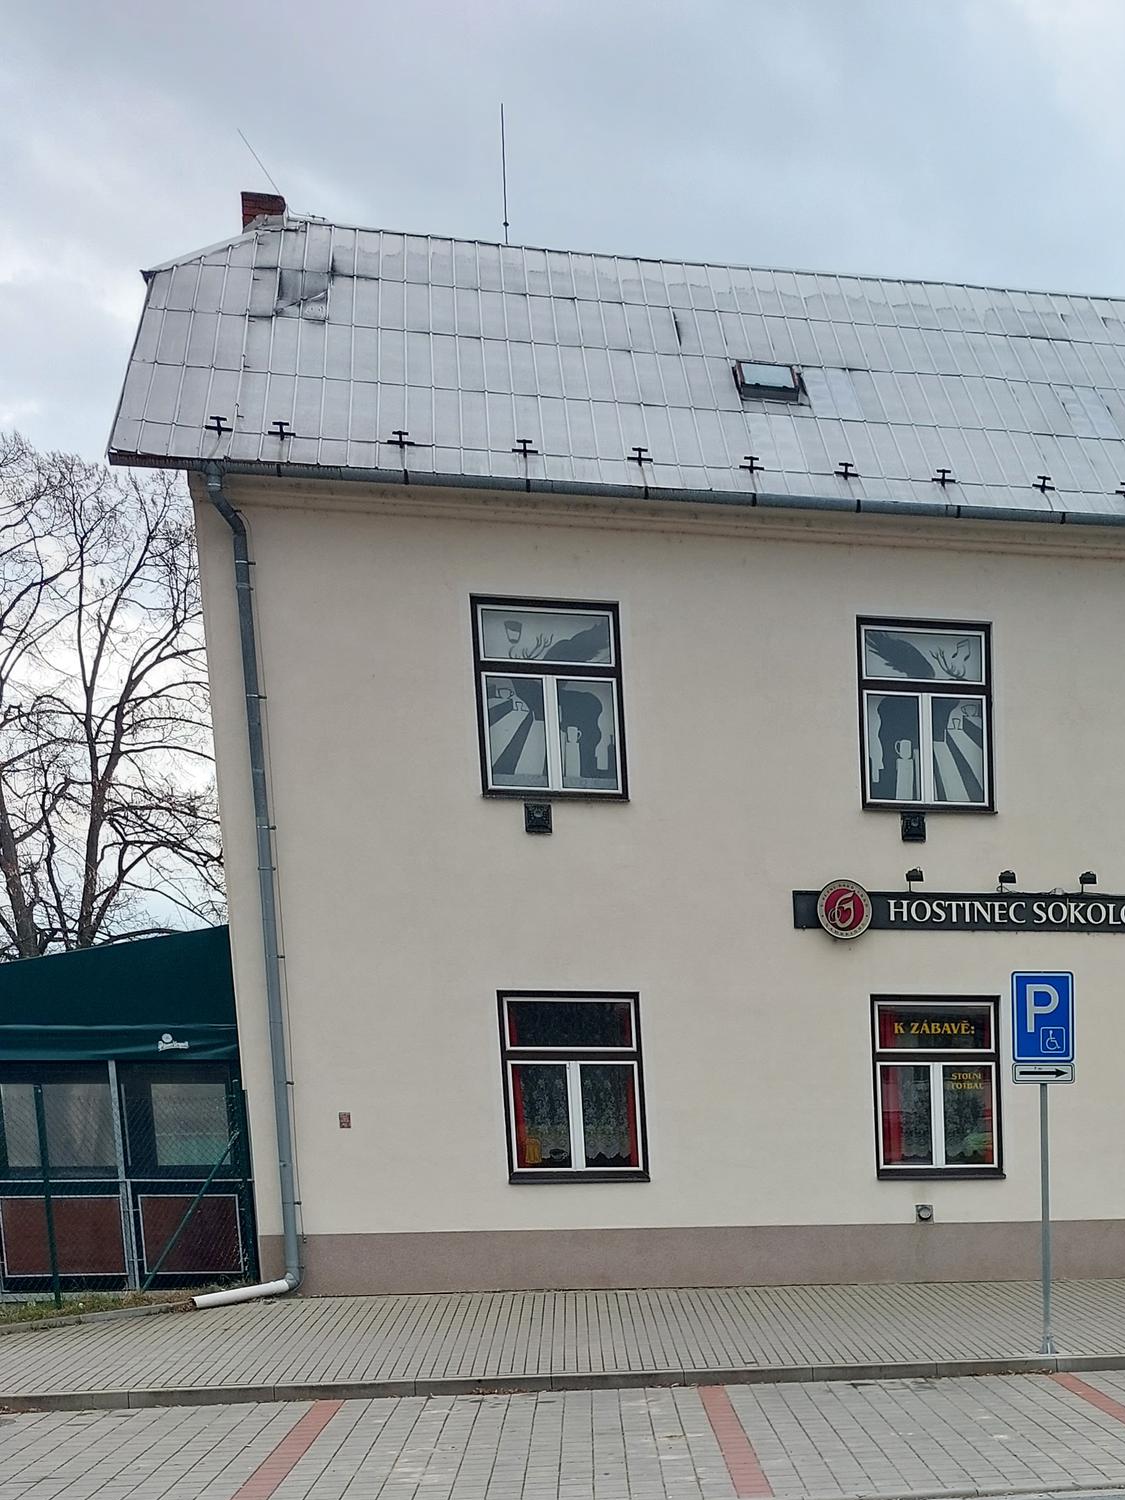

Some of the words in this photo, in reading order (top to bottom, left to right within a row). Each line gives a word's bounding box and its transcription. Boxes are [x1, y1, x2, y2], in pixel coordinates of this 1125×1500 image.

[888, 899, 1026, 924] HOSTINEC
[1026, 984, 1060, 1032] P
[894, 1022, 905, 1034] K
